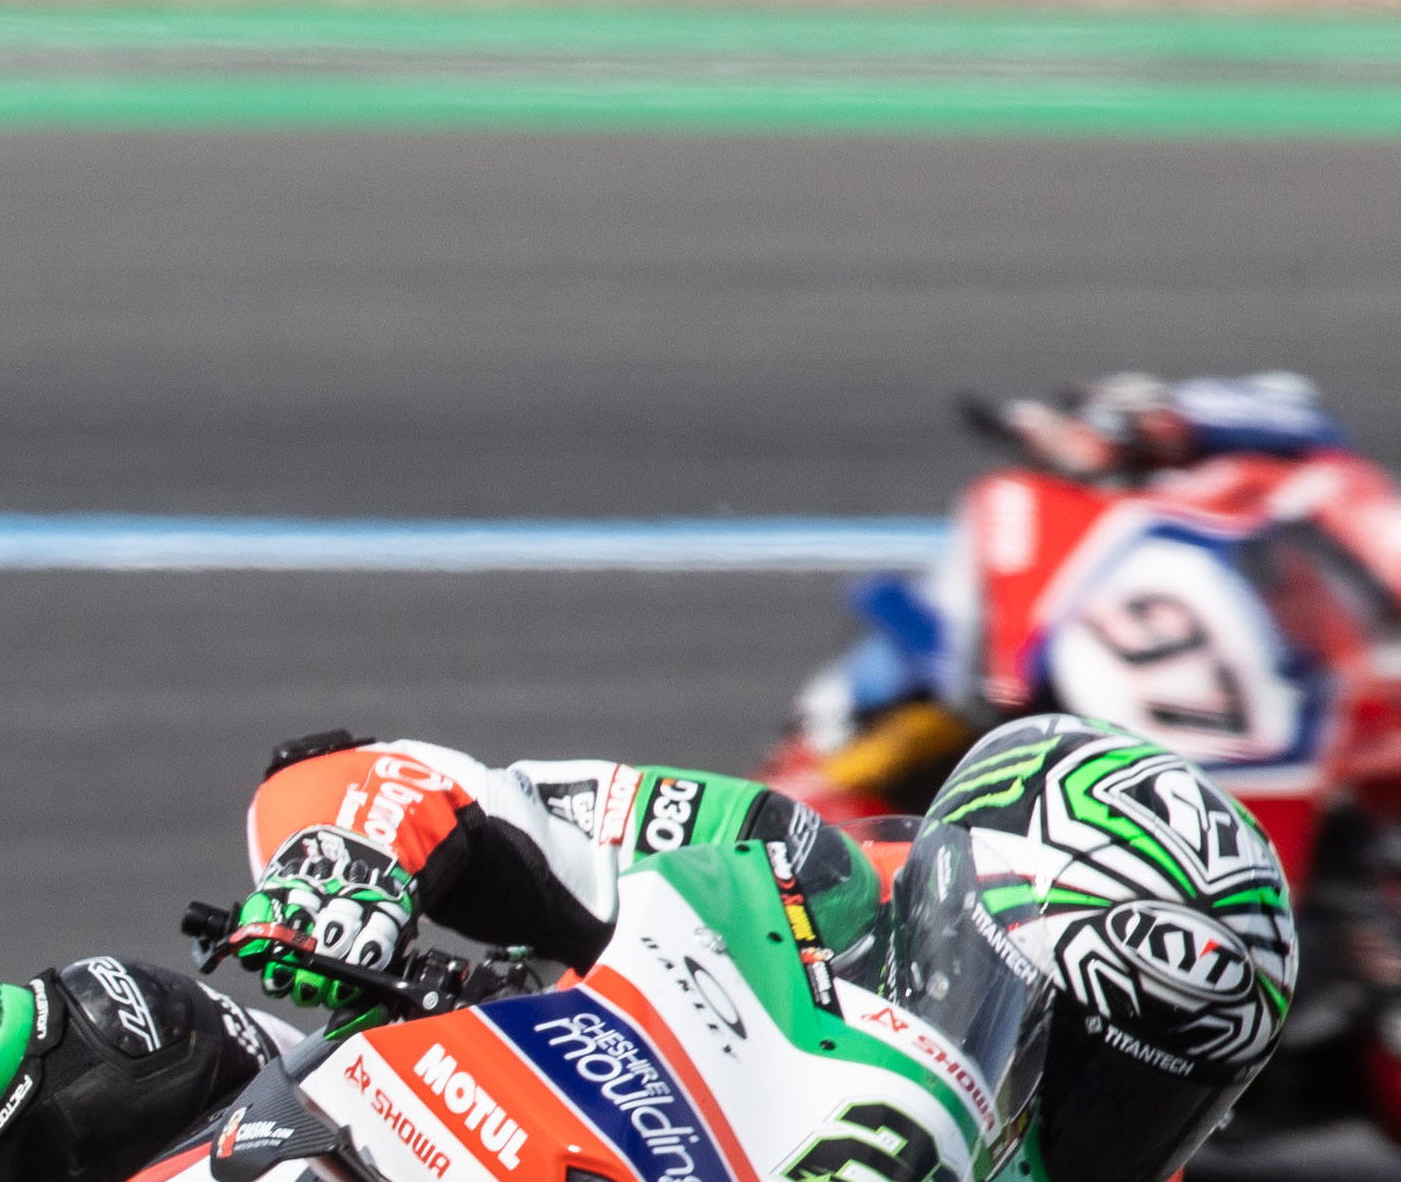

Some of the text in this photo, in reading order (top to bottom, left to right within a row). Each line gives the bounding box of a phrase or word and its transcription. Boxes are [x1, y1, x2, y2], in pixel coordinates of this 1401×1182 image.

[969, 901, 1038, 986] TITANTECH
[1127, 909, 1243, 987] KYT
[573, 1012, 675, 1102] CHESHIRE
[911, 1034, 996, 1132] SHOWA
[1104, 1028, 1197, 1077] TITANTECH
[371, 1087, 450, 1179] SHOWA
[415, 1043, 528, 1171] MOTUL
